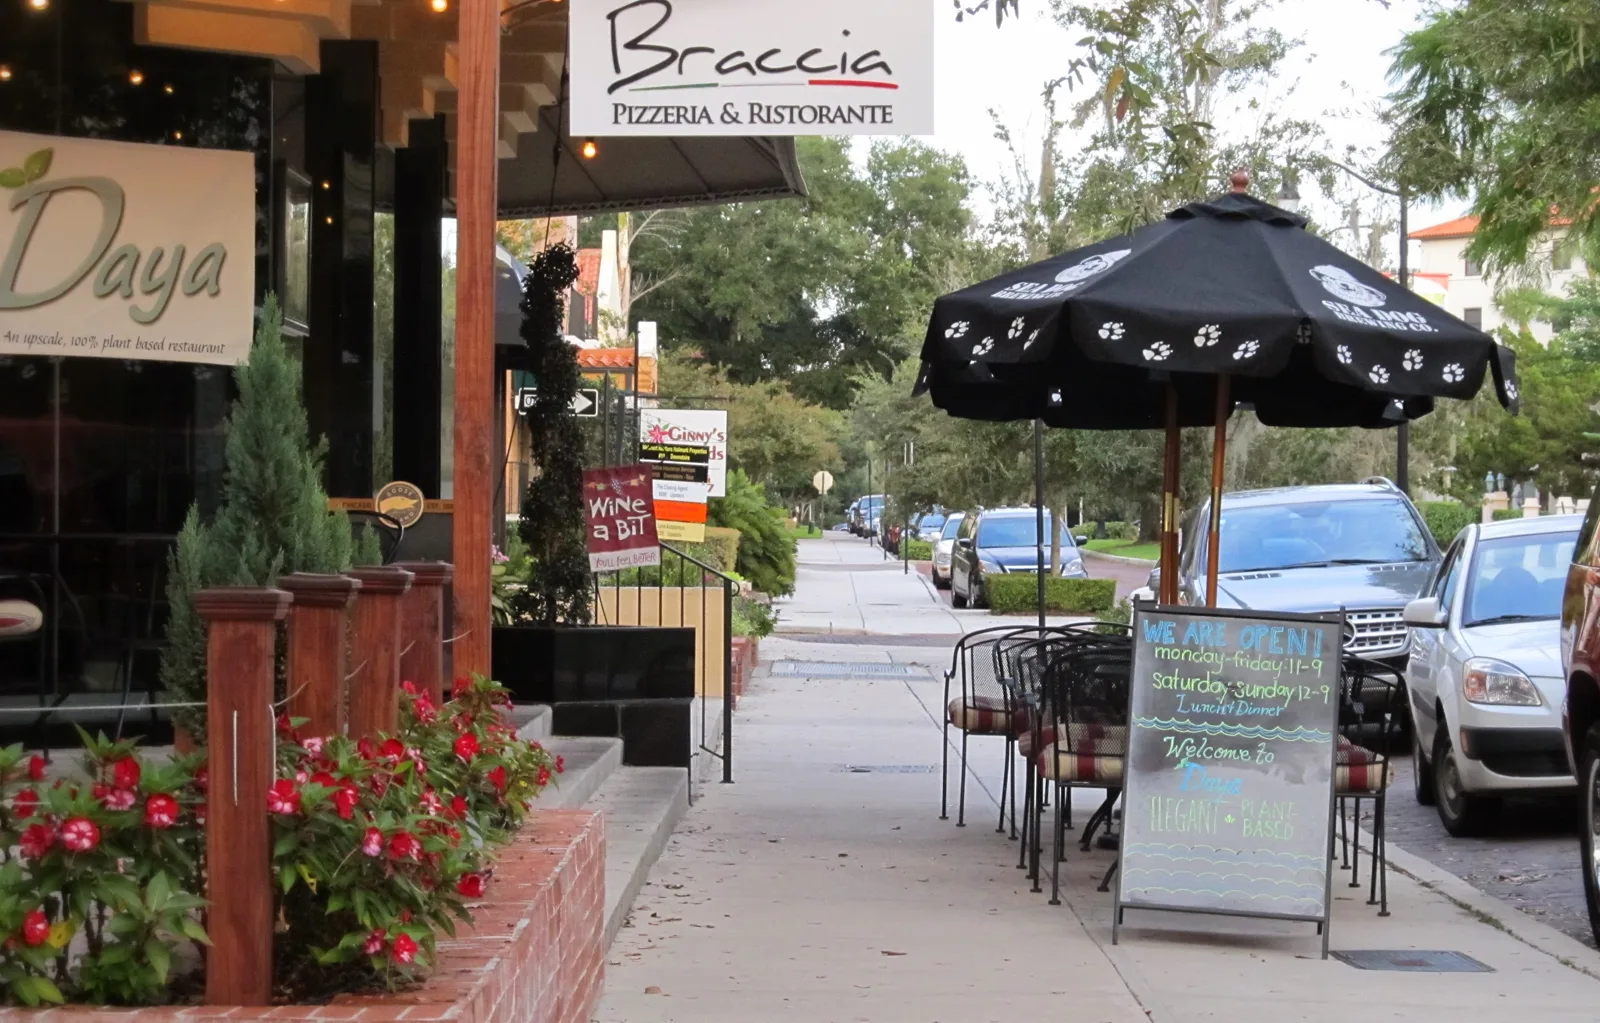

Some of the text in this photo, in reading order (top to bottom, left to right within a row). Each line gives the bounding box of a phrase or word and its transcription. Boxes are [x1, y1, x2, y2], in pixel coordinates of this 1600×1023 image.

[606, 0, 893, 95] Braccia
[612, 102, 893, 124] PIZZERIA & RISTORANTE
[0, 175, 227, 325] Daya
[1322, 300, 1427, 324] SEA DOG
[1332, 311, 1439, 332] BREWING CO.
[4, 330, 226, 354] An upscale, 100% plant based restaurant
[386, 487, 413, 498] GOOSE
[593, 525, 609, 541] a
[1143, 619, 1176, 645] WE
[1182, 620, 1228, 647] ARE
[1298, 684, 1330, 704] 12-9
[1163, 736, 1275, 764] Welcome to
[1242, 818, 1295, 840] BASED
